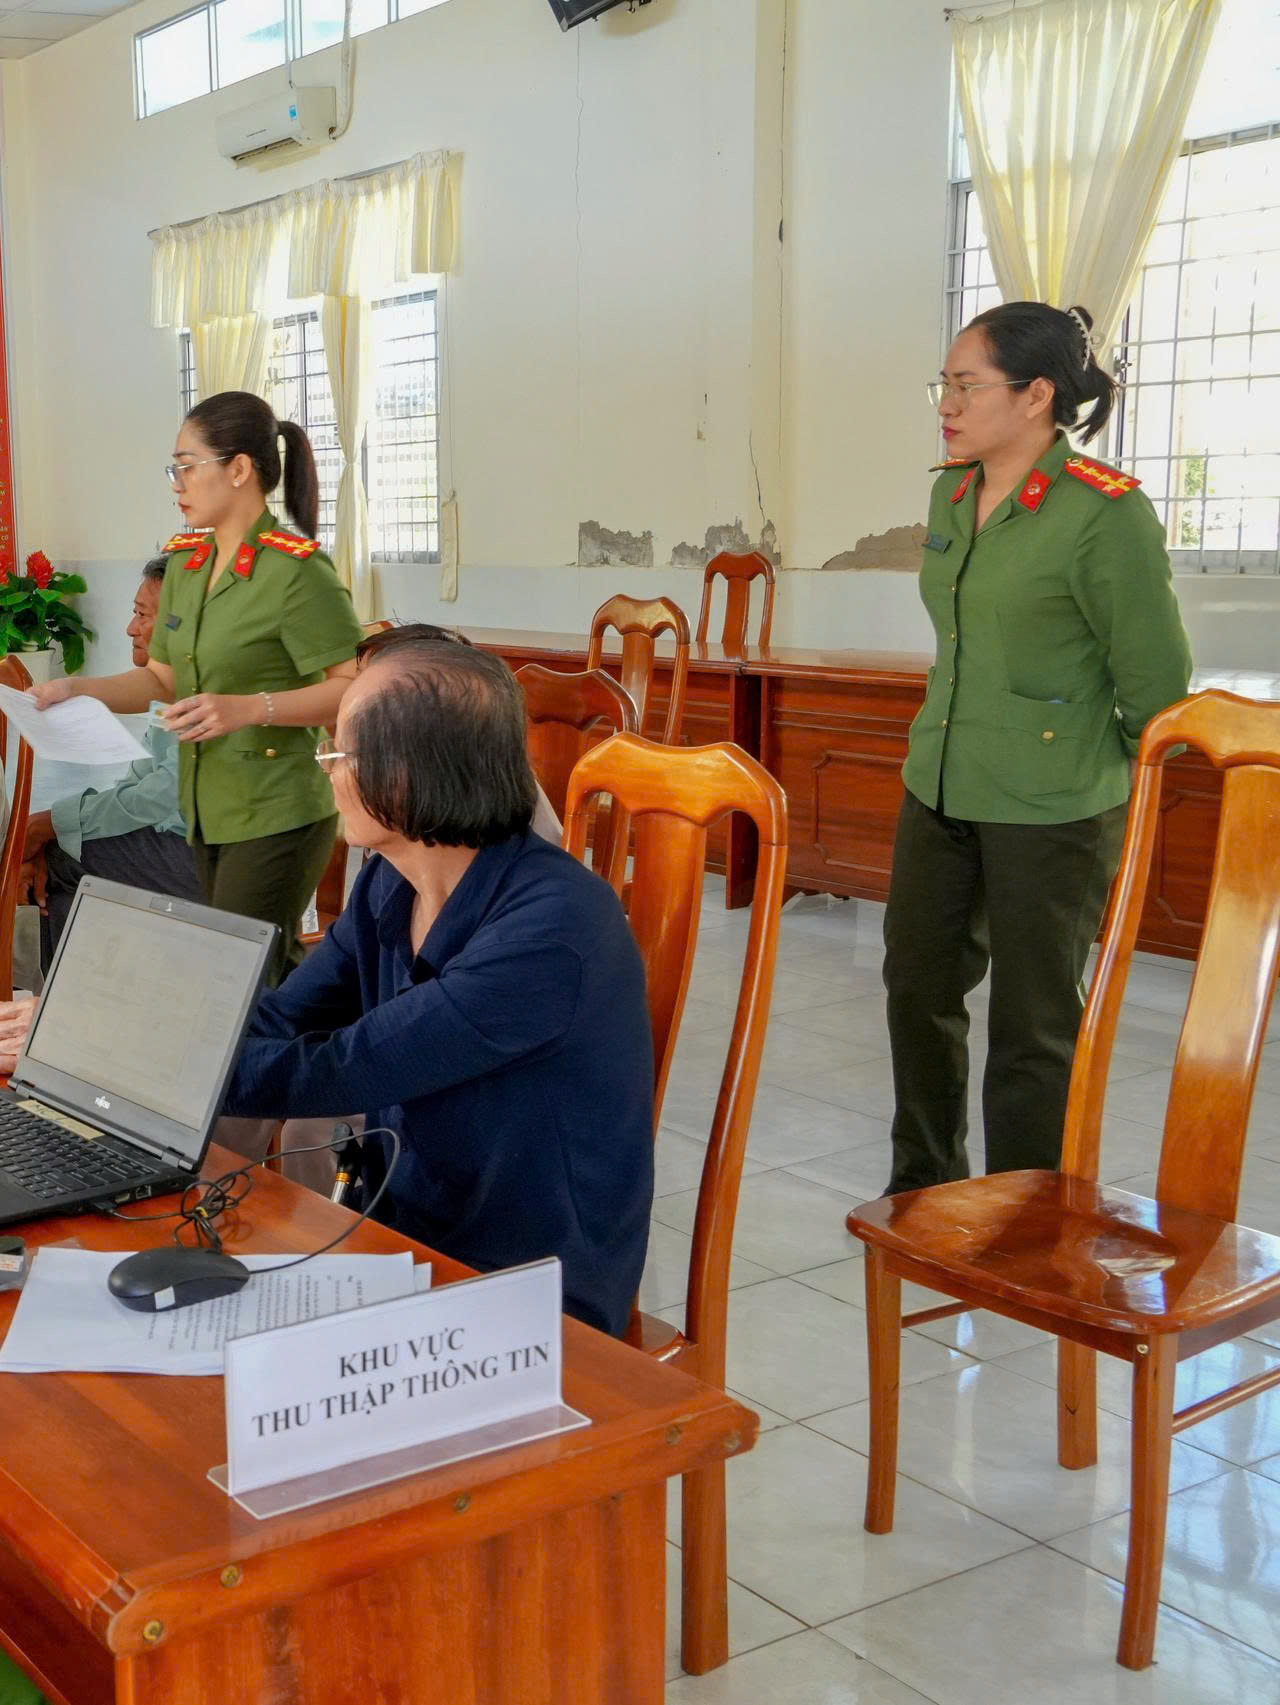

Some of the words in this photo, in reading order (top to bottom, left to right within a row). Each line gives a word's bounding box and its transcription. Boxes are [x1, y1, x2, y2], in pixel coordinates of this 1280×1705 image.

[251, 1402, 313, 1438] THU
[320, 1382, 396, 1416] THẬP
[402, 1355, 498, 1400] THÔNG
[506, 1341, 551, 1373] TIN
[338, 1342, 400, 1379] KHU
[408, 1327, 466, 1362] VỰC
